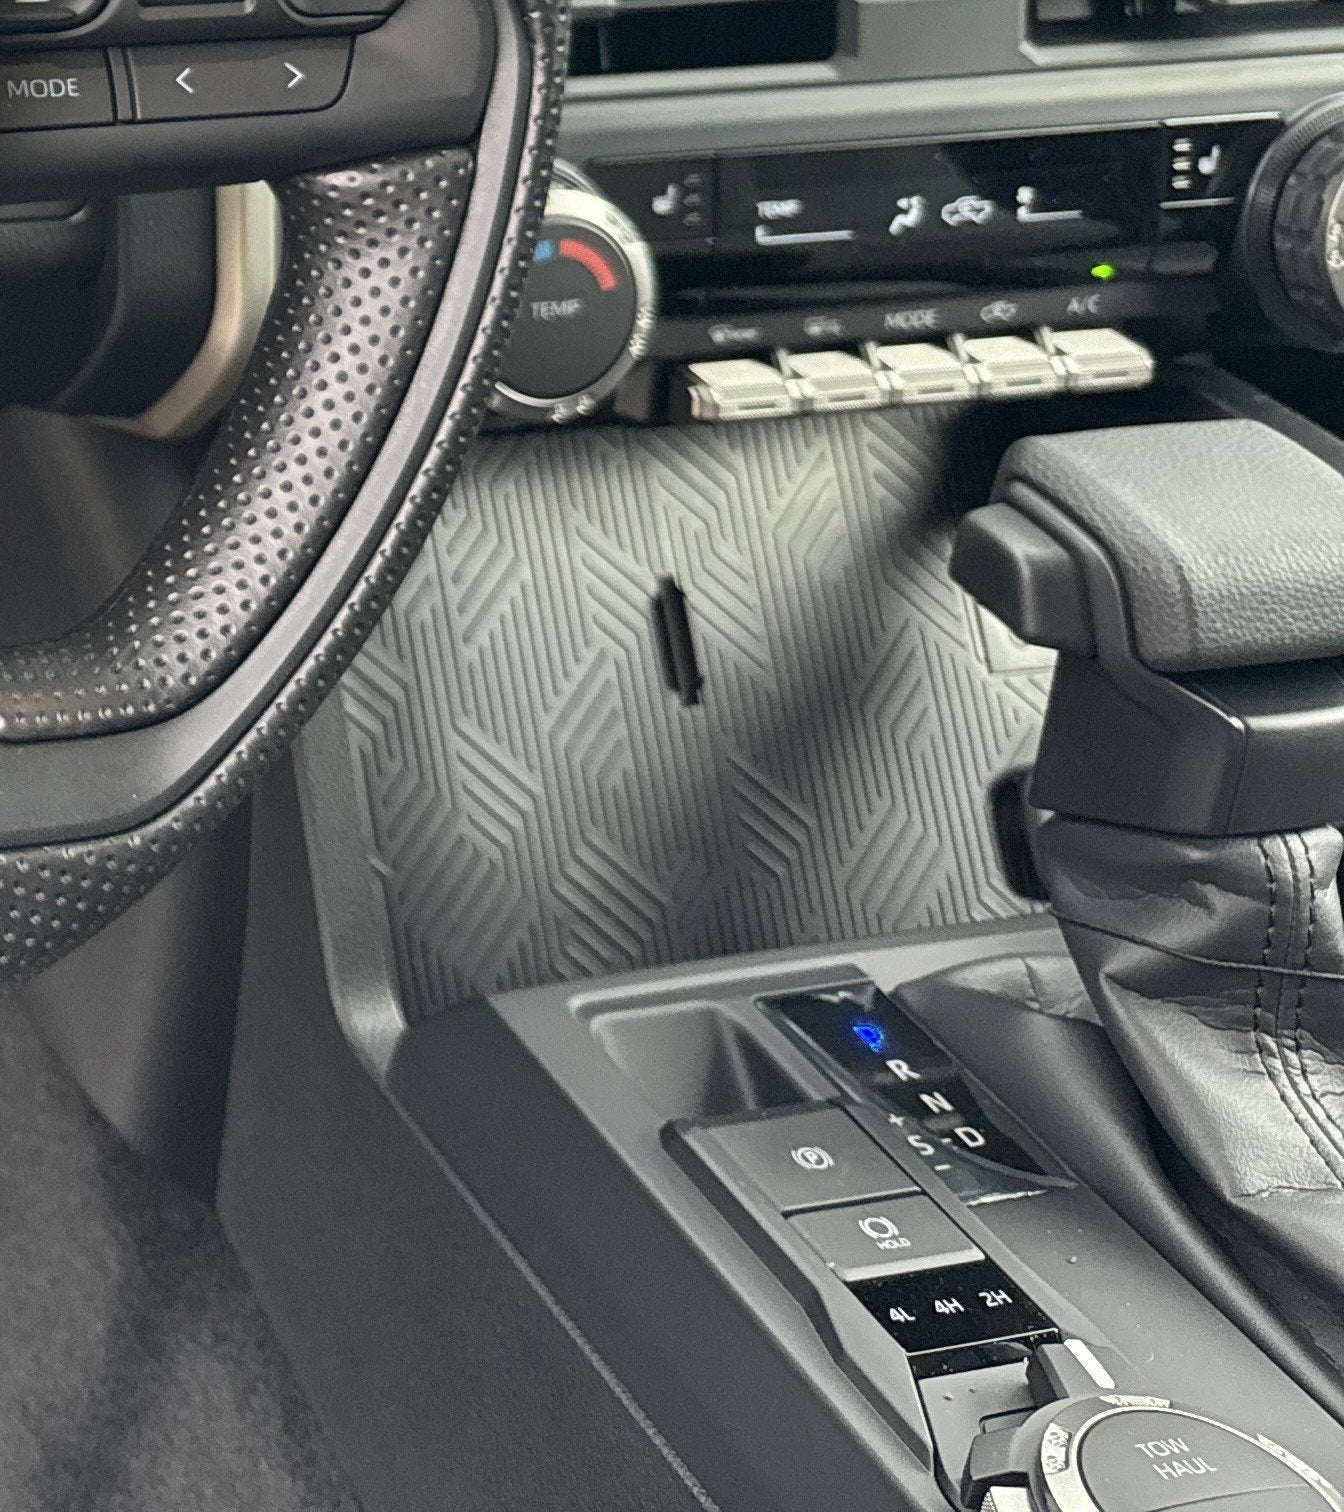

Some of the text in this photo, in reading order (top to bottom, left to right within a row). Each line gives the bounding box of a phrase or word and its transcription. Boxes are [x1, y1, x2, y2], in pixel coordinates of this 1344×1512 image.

[7, 78, 80, 97] MODE
[757, 199, 805, 219] TEMP
[531, 297, 582, 321] TEMP
[1067, 293, 1101, 315] A/C
[884, 308, 941, 331] MODE
[885, 1058, 922, 1082] R
[918, 1091, 955, 1114] N
[907, 1134, 935, 1156] S
[953, 1126, 986, 1149] D
[875, 1238, 912, 1251] HOLD
[889, 1289, 1013, 1324] 4L 4H 2H
[1134, 1437, 1191, 1460] TOW
[1152, 1457, 1218, 1481] HAUL
